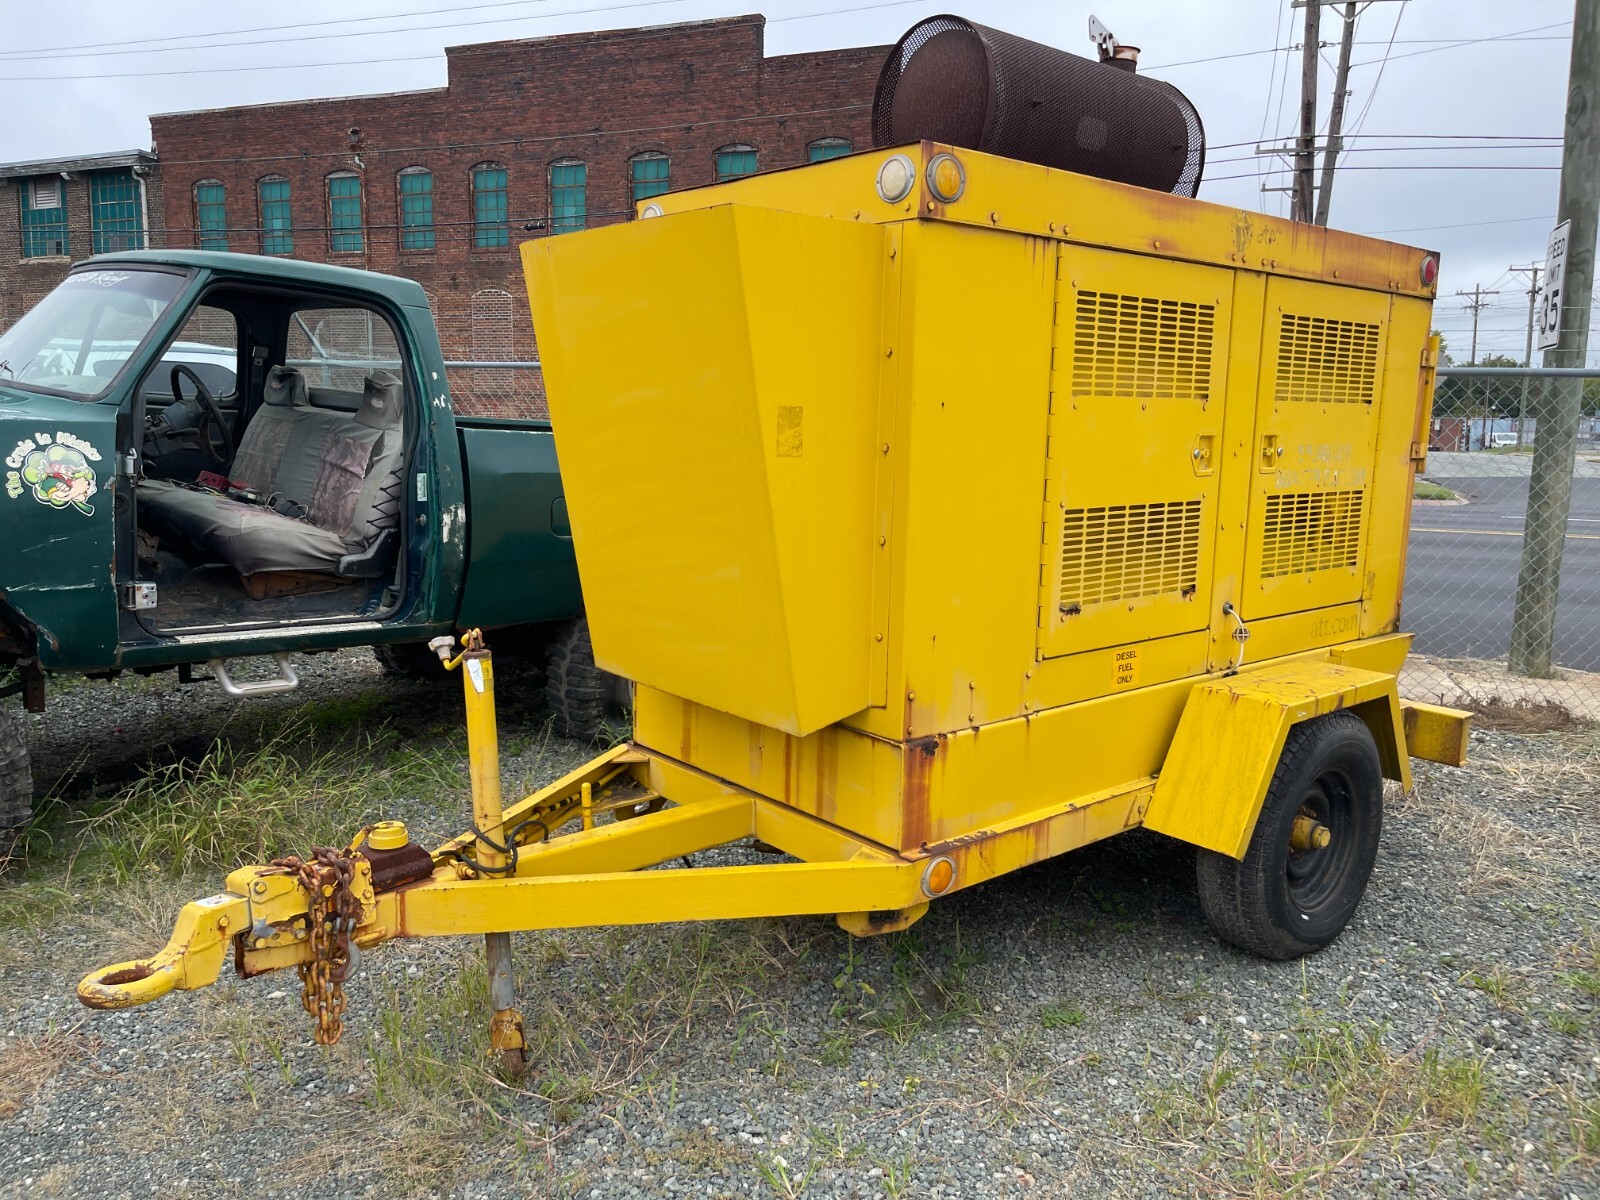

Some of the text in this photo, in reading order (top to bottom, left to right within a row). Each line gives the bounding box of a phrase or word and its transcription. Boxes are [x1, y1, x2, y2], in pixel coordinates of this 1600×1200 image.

[1546, 263, 1561, 287] LIMIT
[1540, 288, 1560, 336] 35
[6, 471, 24, 498] The
[1116, 650, 1137, 661] DIESEL
[1118, 663, 1133, 672] FUEL
[1117, 674, 1133, 684] ONLY
